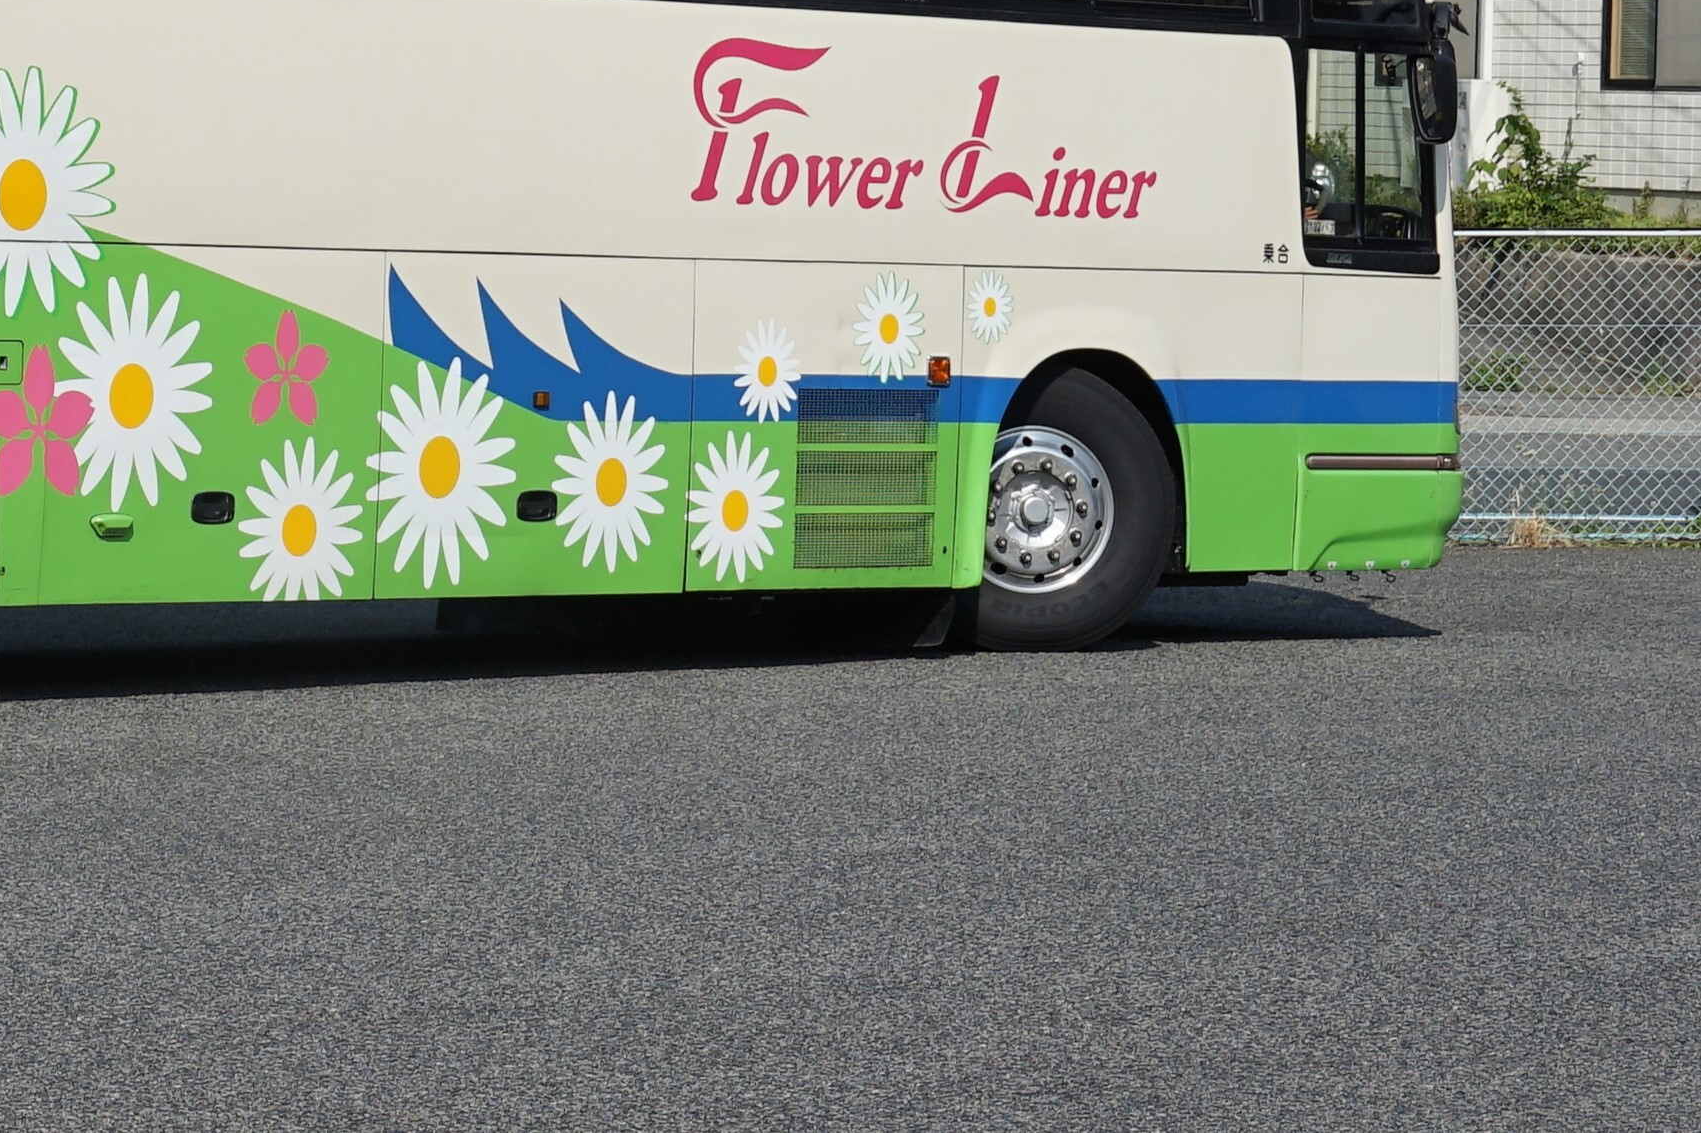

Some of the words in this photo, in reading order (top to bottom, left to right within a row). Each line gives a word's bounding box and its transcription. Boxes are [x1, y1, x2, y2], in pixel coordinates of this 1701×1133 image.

[691, 37, 924, 210] Flower
[940, 75, 1157, 220] Liner
[1262, 242, 1289, 264] 乗合
